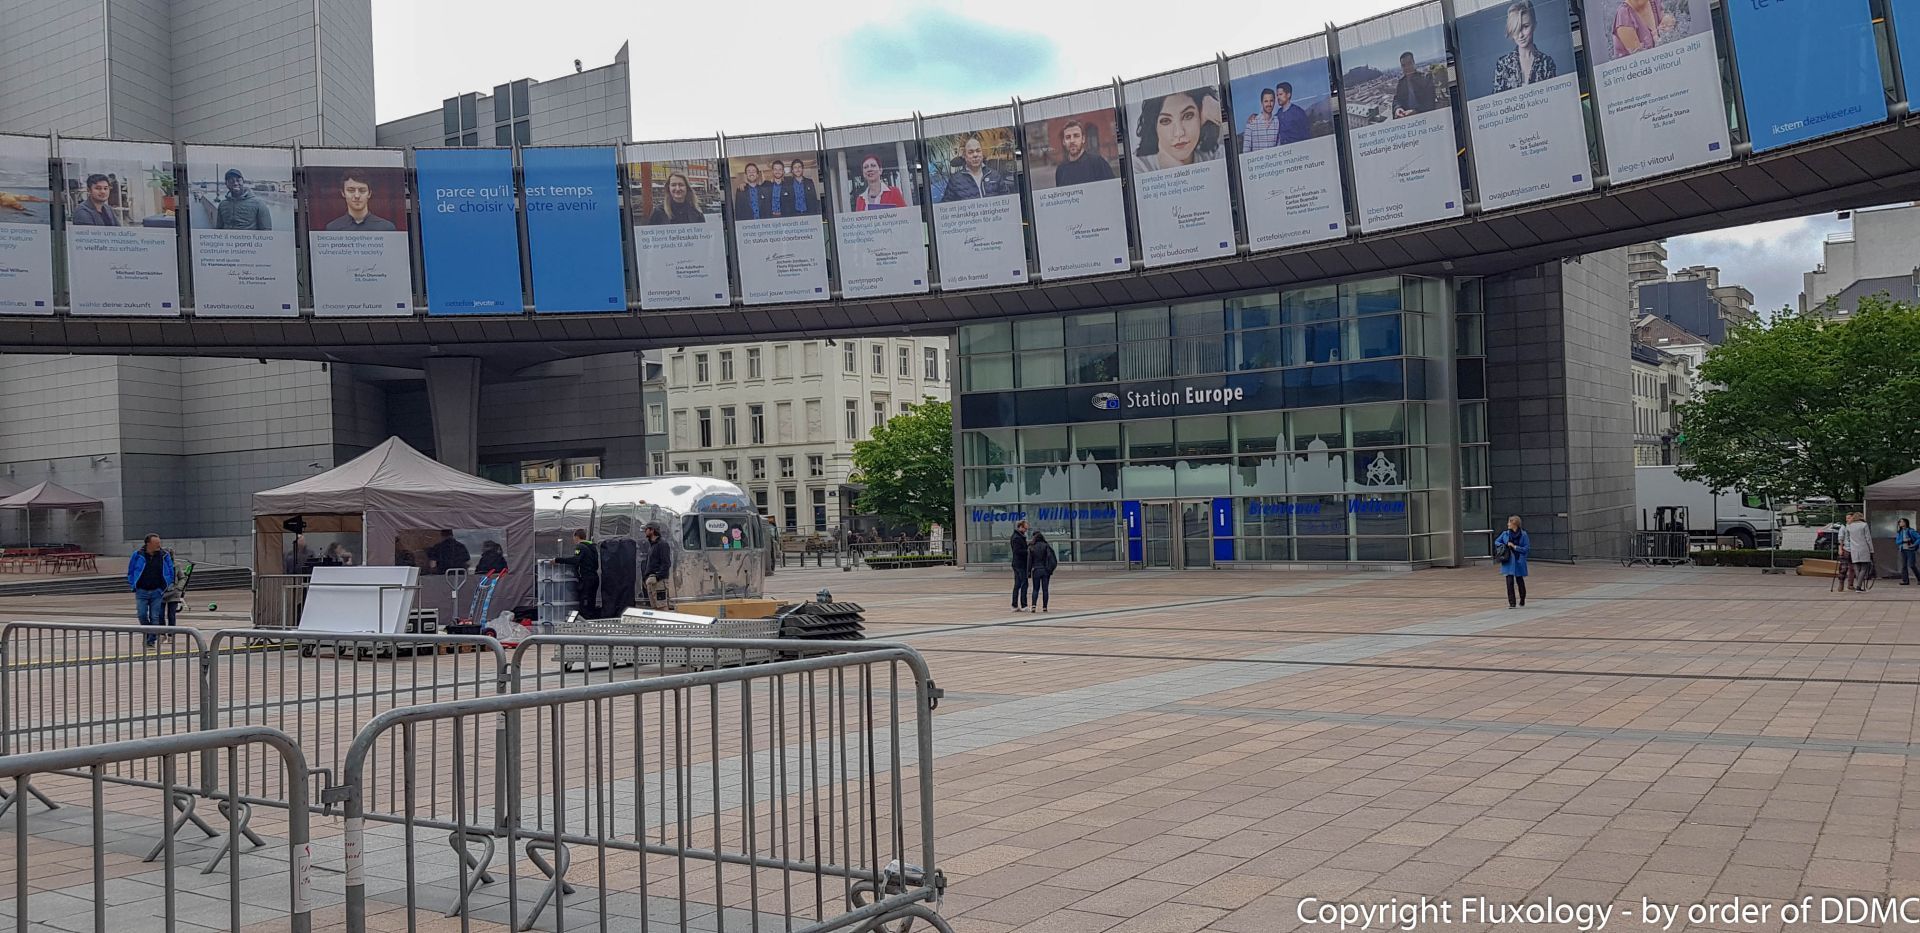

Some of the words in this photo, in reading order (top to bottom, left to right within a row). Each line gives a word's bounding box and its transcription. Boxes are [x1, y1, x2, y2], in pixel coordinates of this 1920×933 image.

[1602, 66, 1628, 78] pentru
[1629, 60, 1638, 69] că
[1652, 50, 1674, 62] vreau
[1675, 47, 1685, 55] ca
[1603, 78, 1612, 88] să
[1626, 67, 1653, 80] decidă
[1654, 57, 1681, 73] viitorul
[1476, 102, 1491, 112] zato
[1492, 98, 1503, 107] što
[1504, 95, 1517, 103] ove
[1519, 88, 1544, 101] godine
[1546, 82, 1572, 92] imamo
[1607, 101, 1623, 110] photo
[1635, 93, 1652, 101] quote
[1648, 95, 1669, 104] contest
[1669, 89, 1689, 98] winner
[1500, 102, 1526, 115] odlučiti
[1526, 98, 1549, 108] kakvu
[1674, 109, 1690, 117] Stana
[1378, 125, 1406, 135] moramo
[1407, 119, 1426, 129] začeti
[1478, 120, 1504, 130] europu
[1505, 112, 1529, 124] želimo
[1772, 105, 1862, 136] ikstemdezekeer.eu
[1359, 138, 1385, 148] zavedati
[1387, 133, 1406, 143] vpliva
[1428, 124, 1444, 133] naše
[1359, 145, 1392, 157] vsakdanje
[1393, 139, 1420, 150] življenje
[1247, 155, 1264, 165] parce
[1265, 154, 1277, 162] que
[1255, 161, 1283, 171] meilleure
[1284, 155, 1310, 165] manière
[1647, 152, 1675, 166] viitorul
[1174, 169, 1190, 179] záleží
[1258, 169, 1285, 180] protéger
[1286, 164, 1303, 173] notre
[1304, 160, 1325, 169] nature
[436, 187, 475, 200] parce
[479, 185, 509, 200] qu'il
[525, 186, 546, 197] est
[550, 185, 593, 198] temps
[1488, 183, 1550, 201] ovajputglasam.eu
[437, 201, 455, 213] de
[459, 200, 503, 213] choisir
[557, 199, 597, 212] avenir
[1386, 203, 1403, 212] svojo
[1368, 212, 1404, 224] prihodnost
[1257, 229, 1311, 243] cettefoisjevote.eu
[1150, 251, 1166, 259] svoju
[1167, 246, 1199, 256] budúcnosť
[1127, 389, 1179, 408] Station
[1185, 386, 1244, 406] Europe
[972, 506, 1027, 522] Welcome
[1038, 505, 1117, 520] Willkommen
[1248, 500, 1321, 515] Bienvenue
[1348, 498, 1406, 513] Welkom
